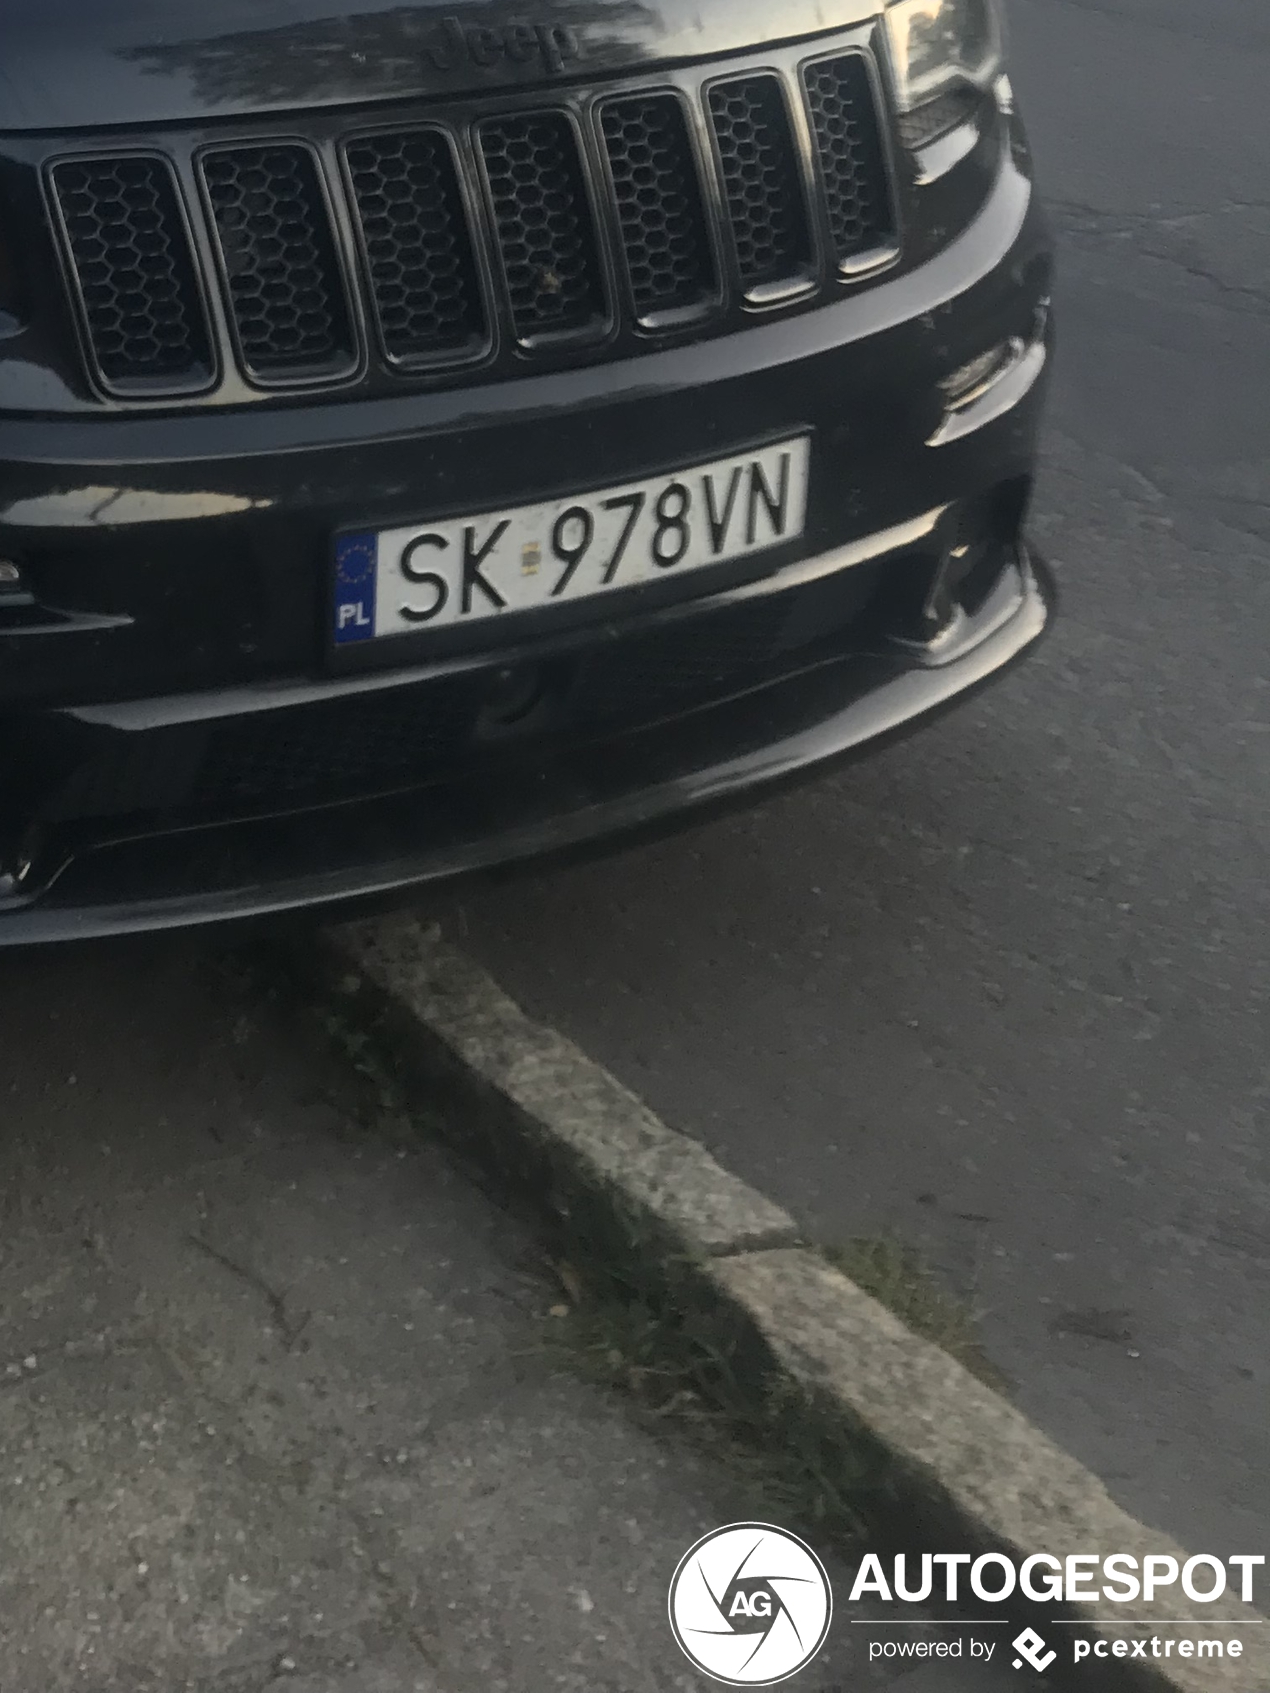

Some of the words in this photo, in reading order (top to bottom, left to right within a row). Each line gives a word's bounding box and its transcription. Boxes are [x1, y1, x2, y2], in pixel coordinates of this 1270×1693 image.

[425, 15, 579, 73] Jeep
[398, 519, 509, 623] SK
[550, 452, 792, 597] 978VN
[336, 602, 371, 630] PL
